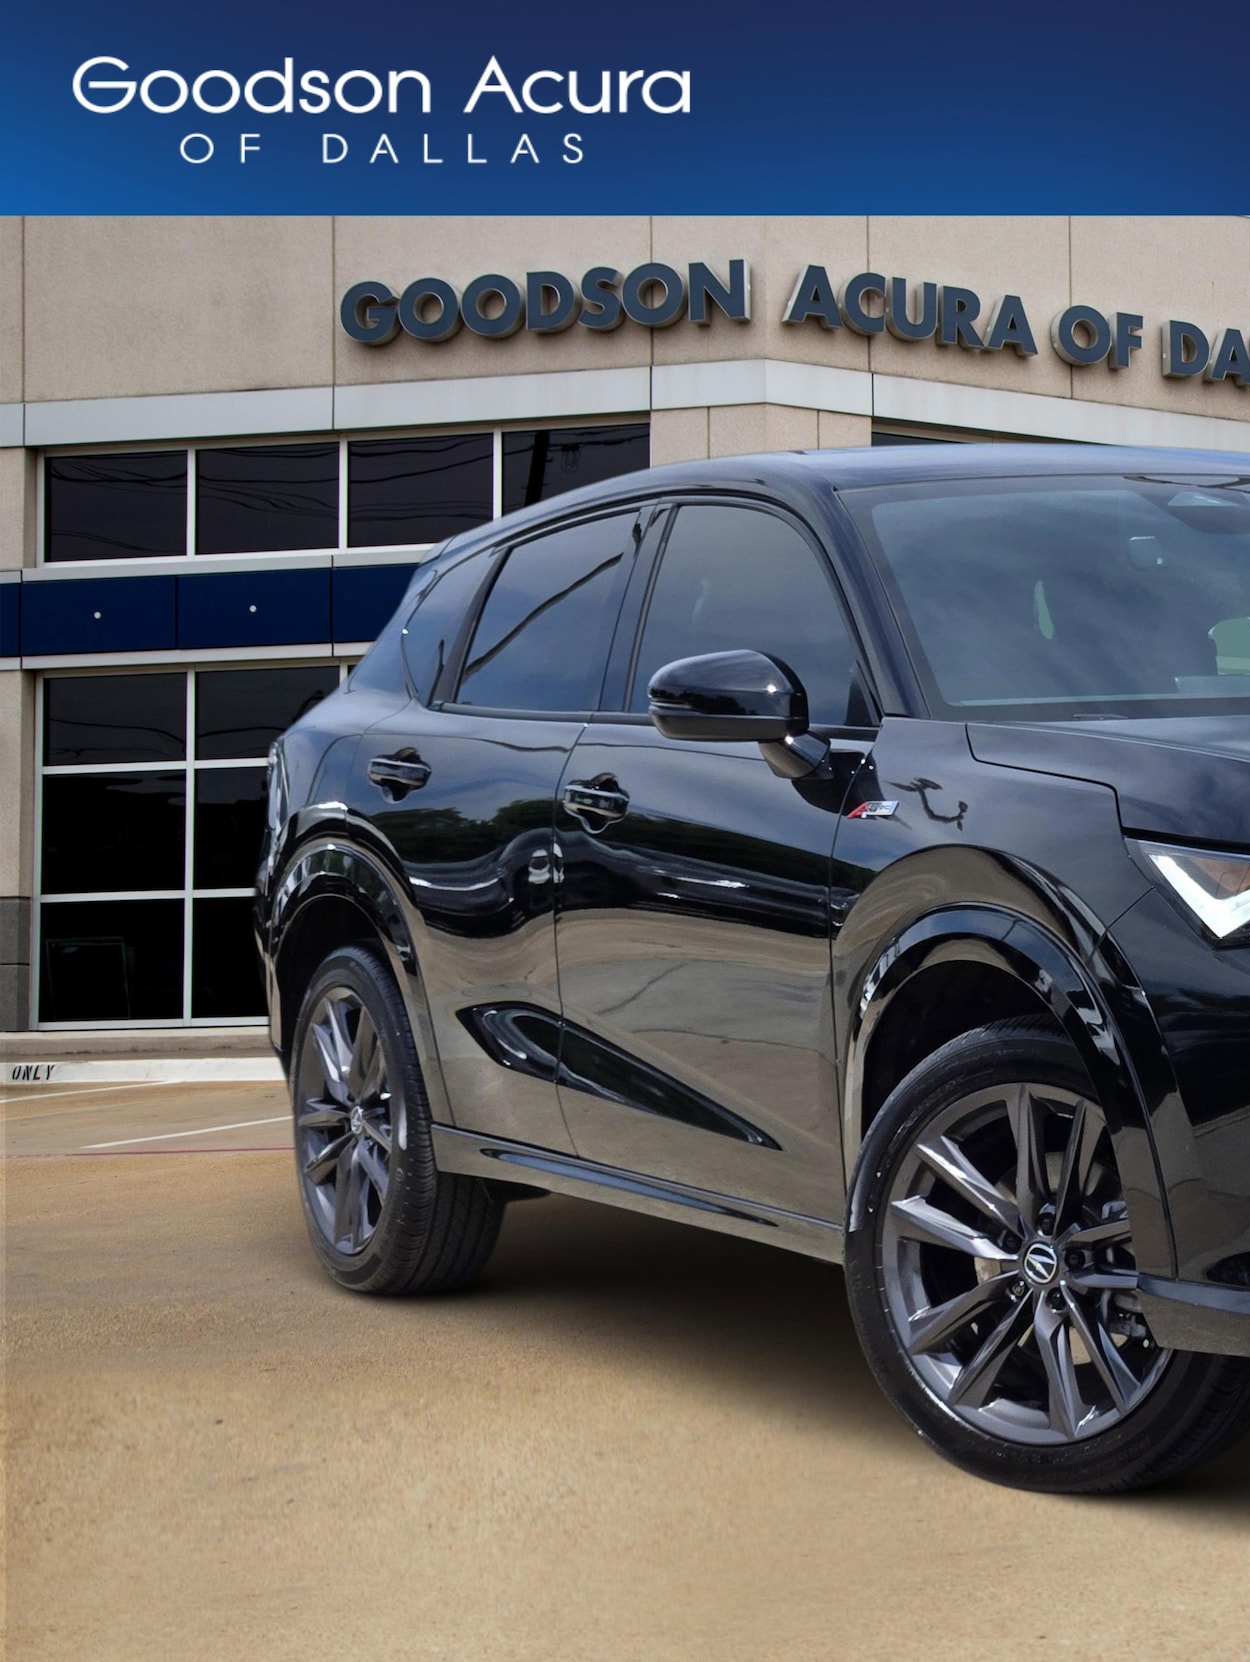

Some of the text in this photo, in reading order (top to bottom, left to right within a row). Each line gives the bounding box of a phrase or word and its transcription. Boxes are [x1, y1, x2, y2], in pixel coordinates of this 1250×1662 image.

[340, 259, 751, 345] GOODSON
[782, 264, 1038, 357] ACURA
[1051, 304, 1144, 370] OF
[11, 1064, 56, 1081] ONLY
